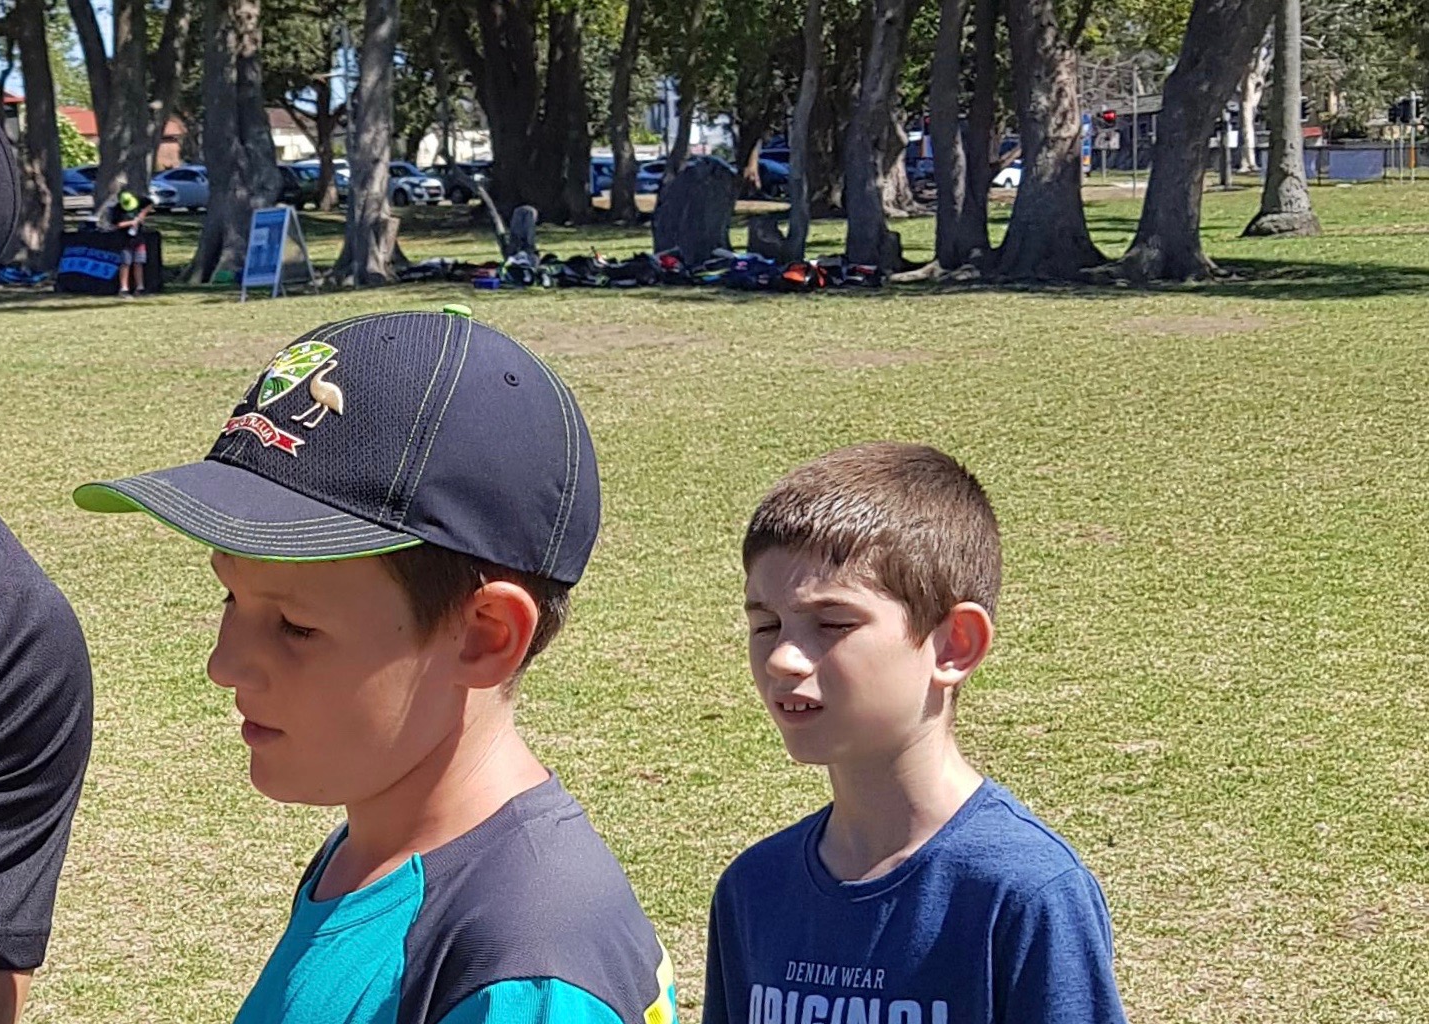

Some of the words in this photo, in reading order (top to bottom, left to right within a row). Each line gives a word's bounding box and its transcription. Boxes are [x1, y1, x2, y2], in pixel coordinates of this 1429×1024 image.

[227, 415, 274, 441] STRALIA
[785, 960, 839, 987] DENIM
[840, 966, 886, 990] WEAR
